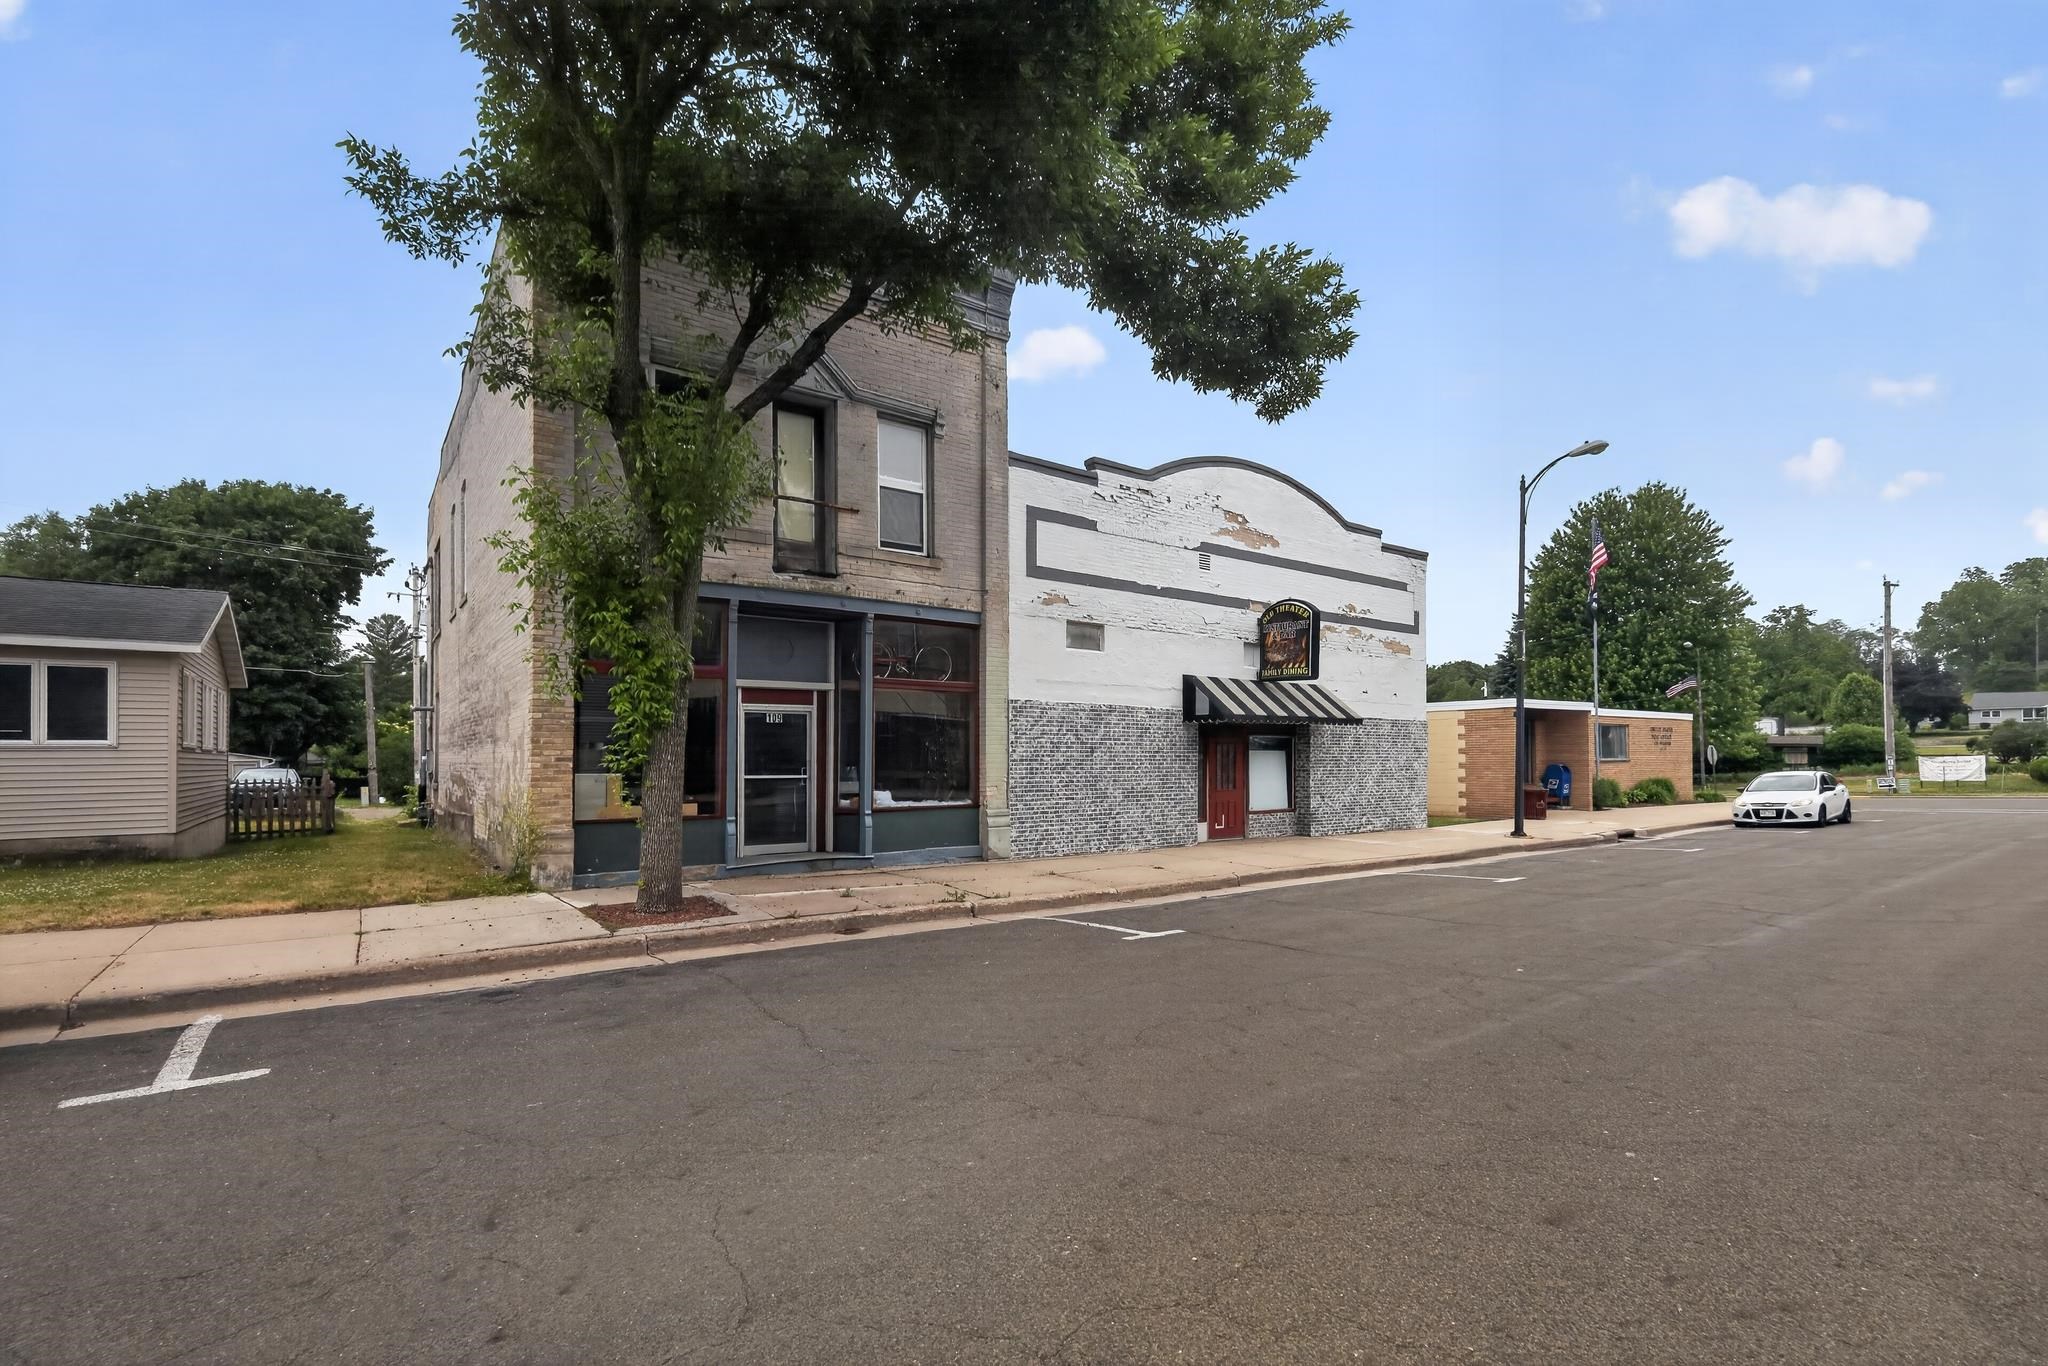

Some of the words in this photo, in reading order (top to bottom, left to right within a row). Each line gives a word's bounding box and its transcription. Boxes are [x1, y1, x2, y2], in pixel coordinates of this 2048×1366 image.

[1262, 611, 1275, 624] OLD
[1276, 604, 1309, 618] THEATER
[1283, 667, 1308, 675] DINING
[767, 713, 782, 723] 109
